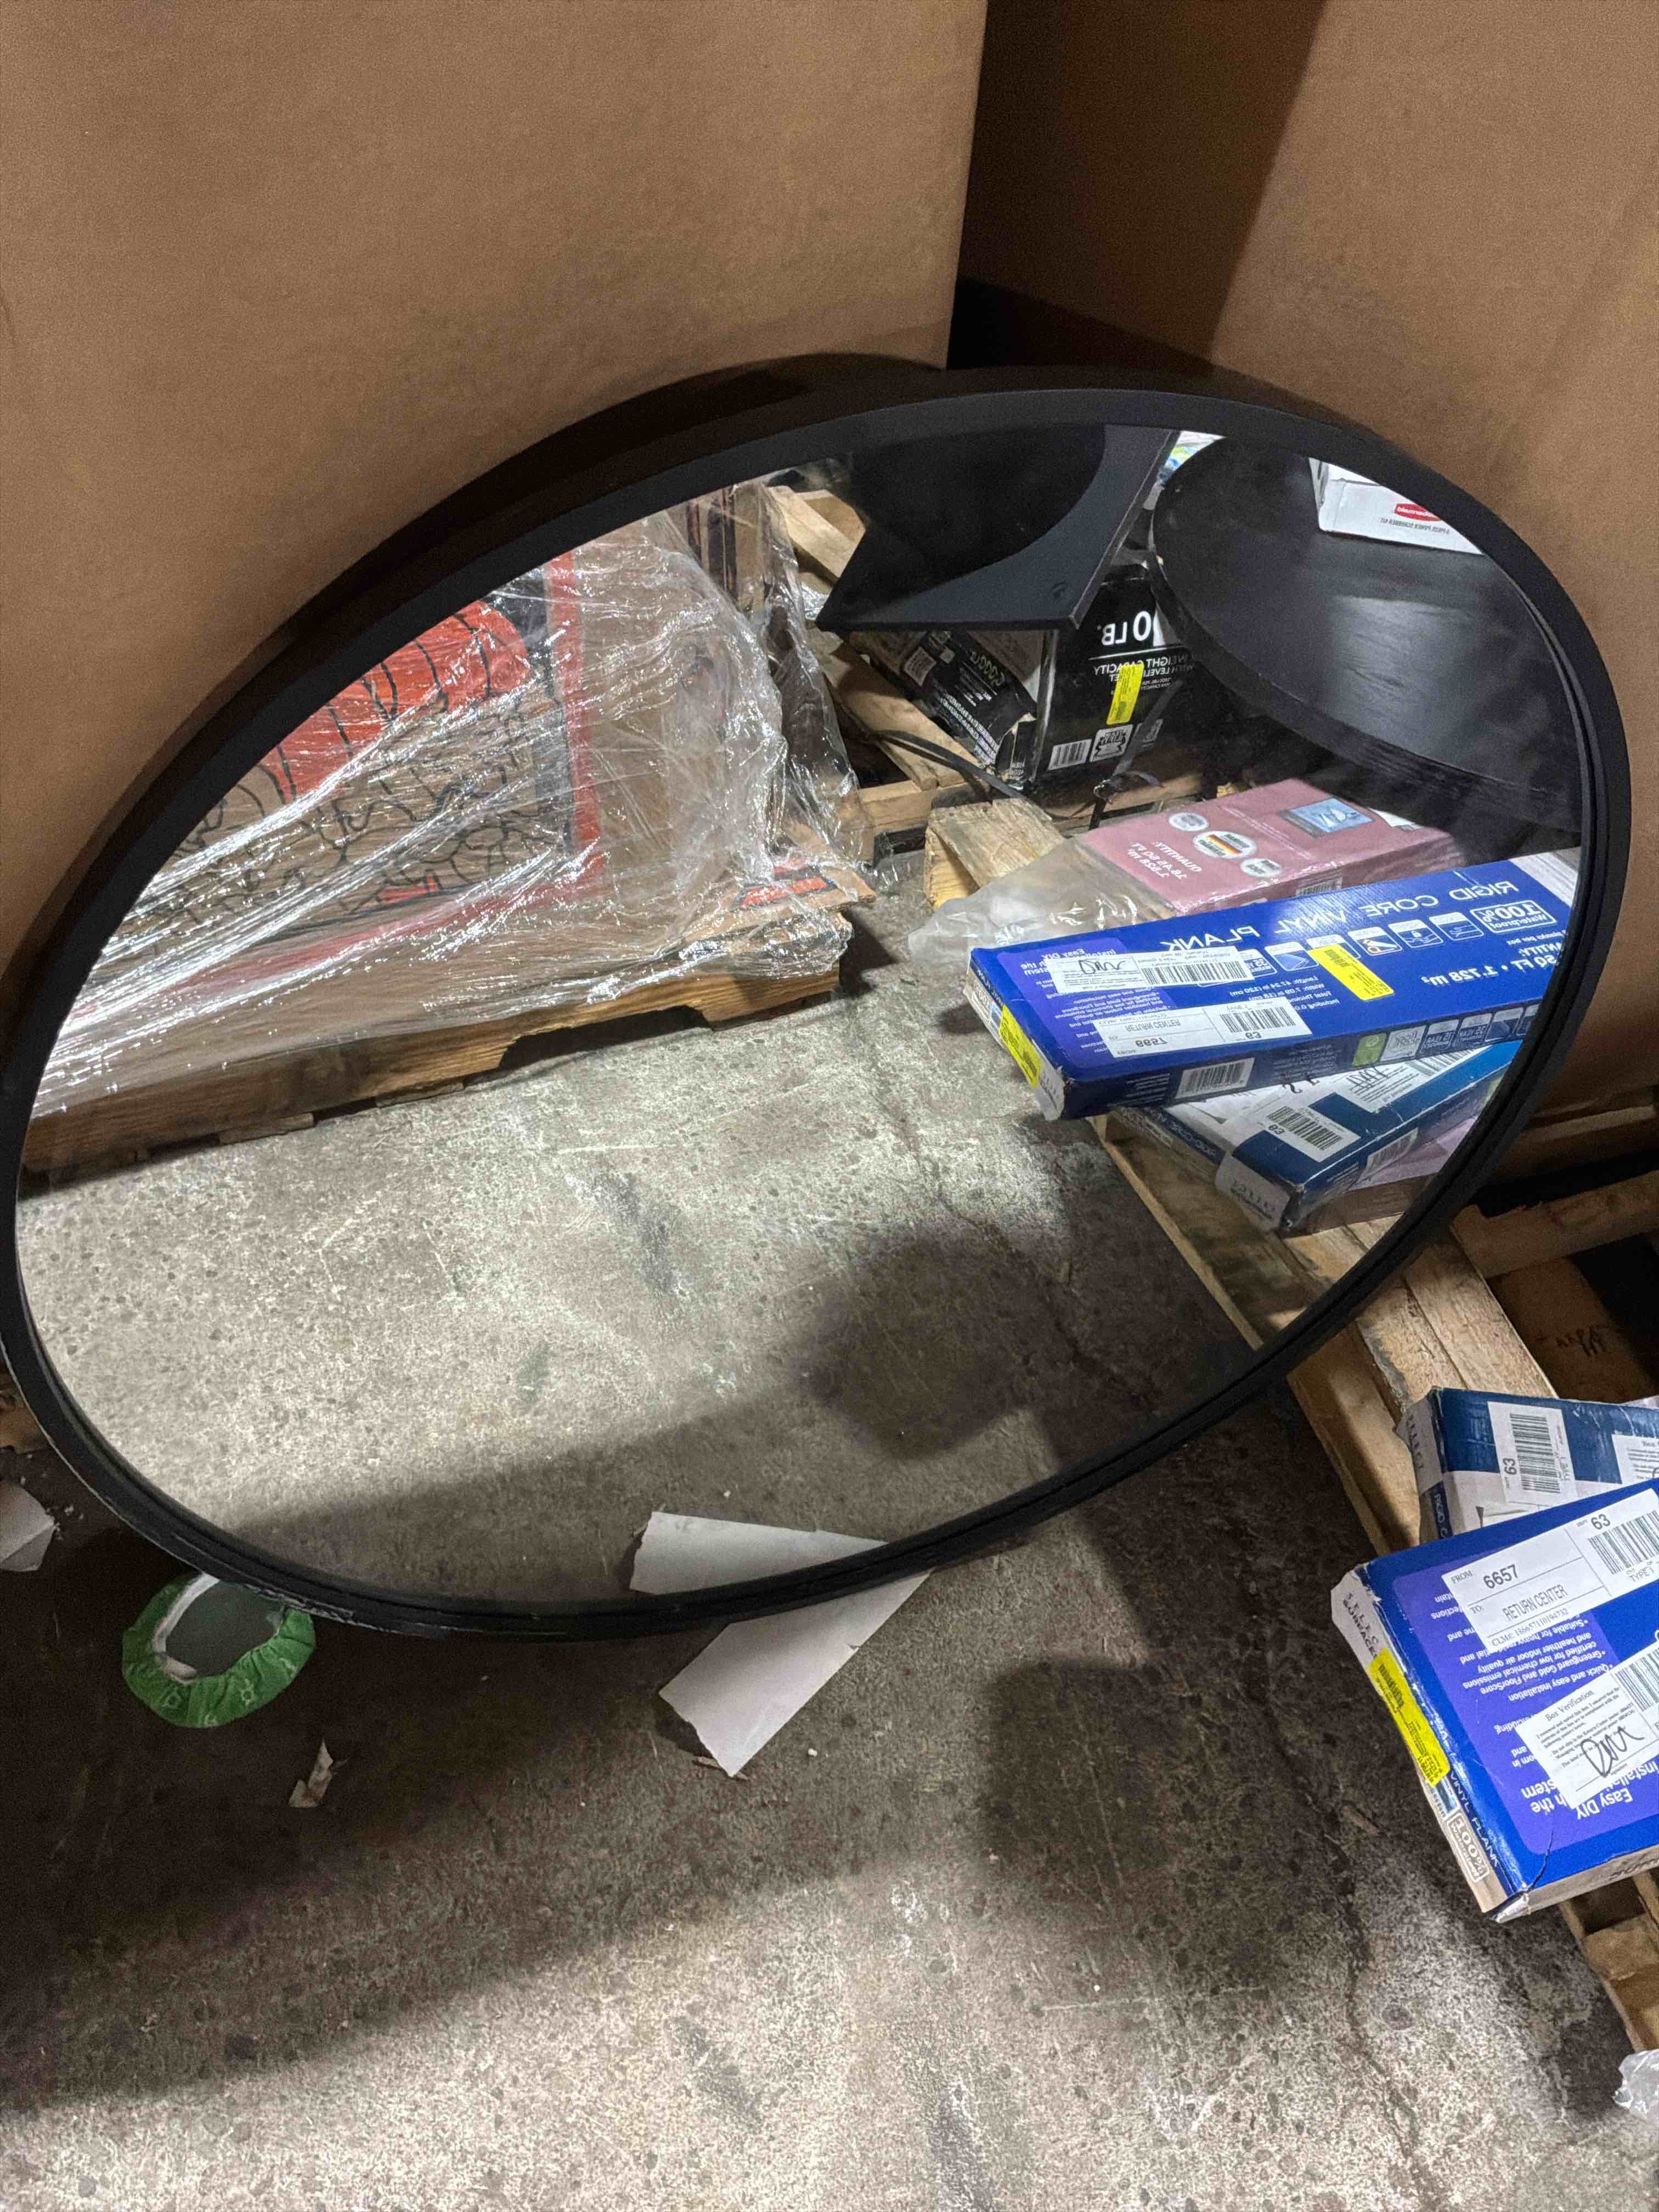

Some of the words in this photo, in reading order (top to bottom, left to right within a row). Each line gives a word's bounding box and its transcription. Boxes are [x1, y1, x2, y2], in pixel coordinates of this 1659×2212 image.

[1500, 1457, 1519, 1476] 63
[1589, 1511, 1612, 1532] 63
[1482, 1563, 1521, 1590] 6657
[1502, 1595, 1538, 1622] RETURN
[1532, 1582, 1569, 1609] CENTER
[1447, 1629, 1463, 1642] and
[1539, 1627, 1553, 1639] for
[1551, 1617, 1584, 1636] Suitable
[1541, 1635, 1577, 1655] healthier
[1575, 1630, 1593, 1643] and
[1515, 1646, 1542, 1663] indoor
[1553, 1650, 1566, 1661] for
[1564, 1638, 1598, 1658] certified
[1458, 1652, 1476, 1666] and
[1475, 1656, 1505, 1675] quality
[1502, 1657, 1539, 1679] chemical
[1504, 1655, 1516, 1666] air
[1537, 1653, 1554, 1666] low
[1555, 1646, 1602, 1673] Greenguard
[1521, 1669, 1538, 1683] and
[1537, 1662, 1558, 1678] Gold
[1569, 1669, 1587, 1682] and
[1585, 1661, 1609, 1678] Quick
[1461, 1668, 1503, 1691] emissions
[1479, 1673, 1523, 1698] FloorScore
[1550, 1673, 1570, 1688] easy
[1507, 1680, 1552, 1705] Installation
[1544, 1708, 1560, 1722] Box
[1557, 1689, 1596, 1714] Verification
[1510, 1745, 1528, 1757] and
[1529, 1796, 1553, 1815] the
[1596, 1787, 1633, 1810] Easy
[1573, 1798, 1599, 1820] DIY
[1445, 1771, 1475, 1813] VINYL
[1468, 1816, 1503, 1867] PLANK
[1451, 1817, 1491, 1875] 100%
